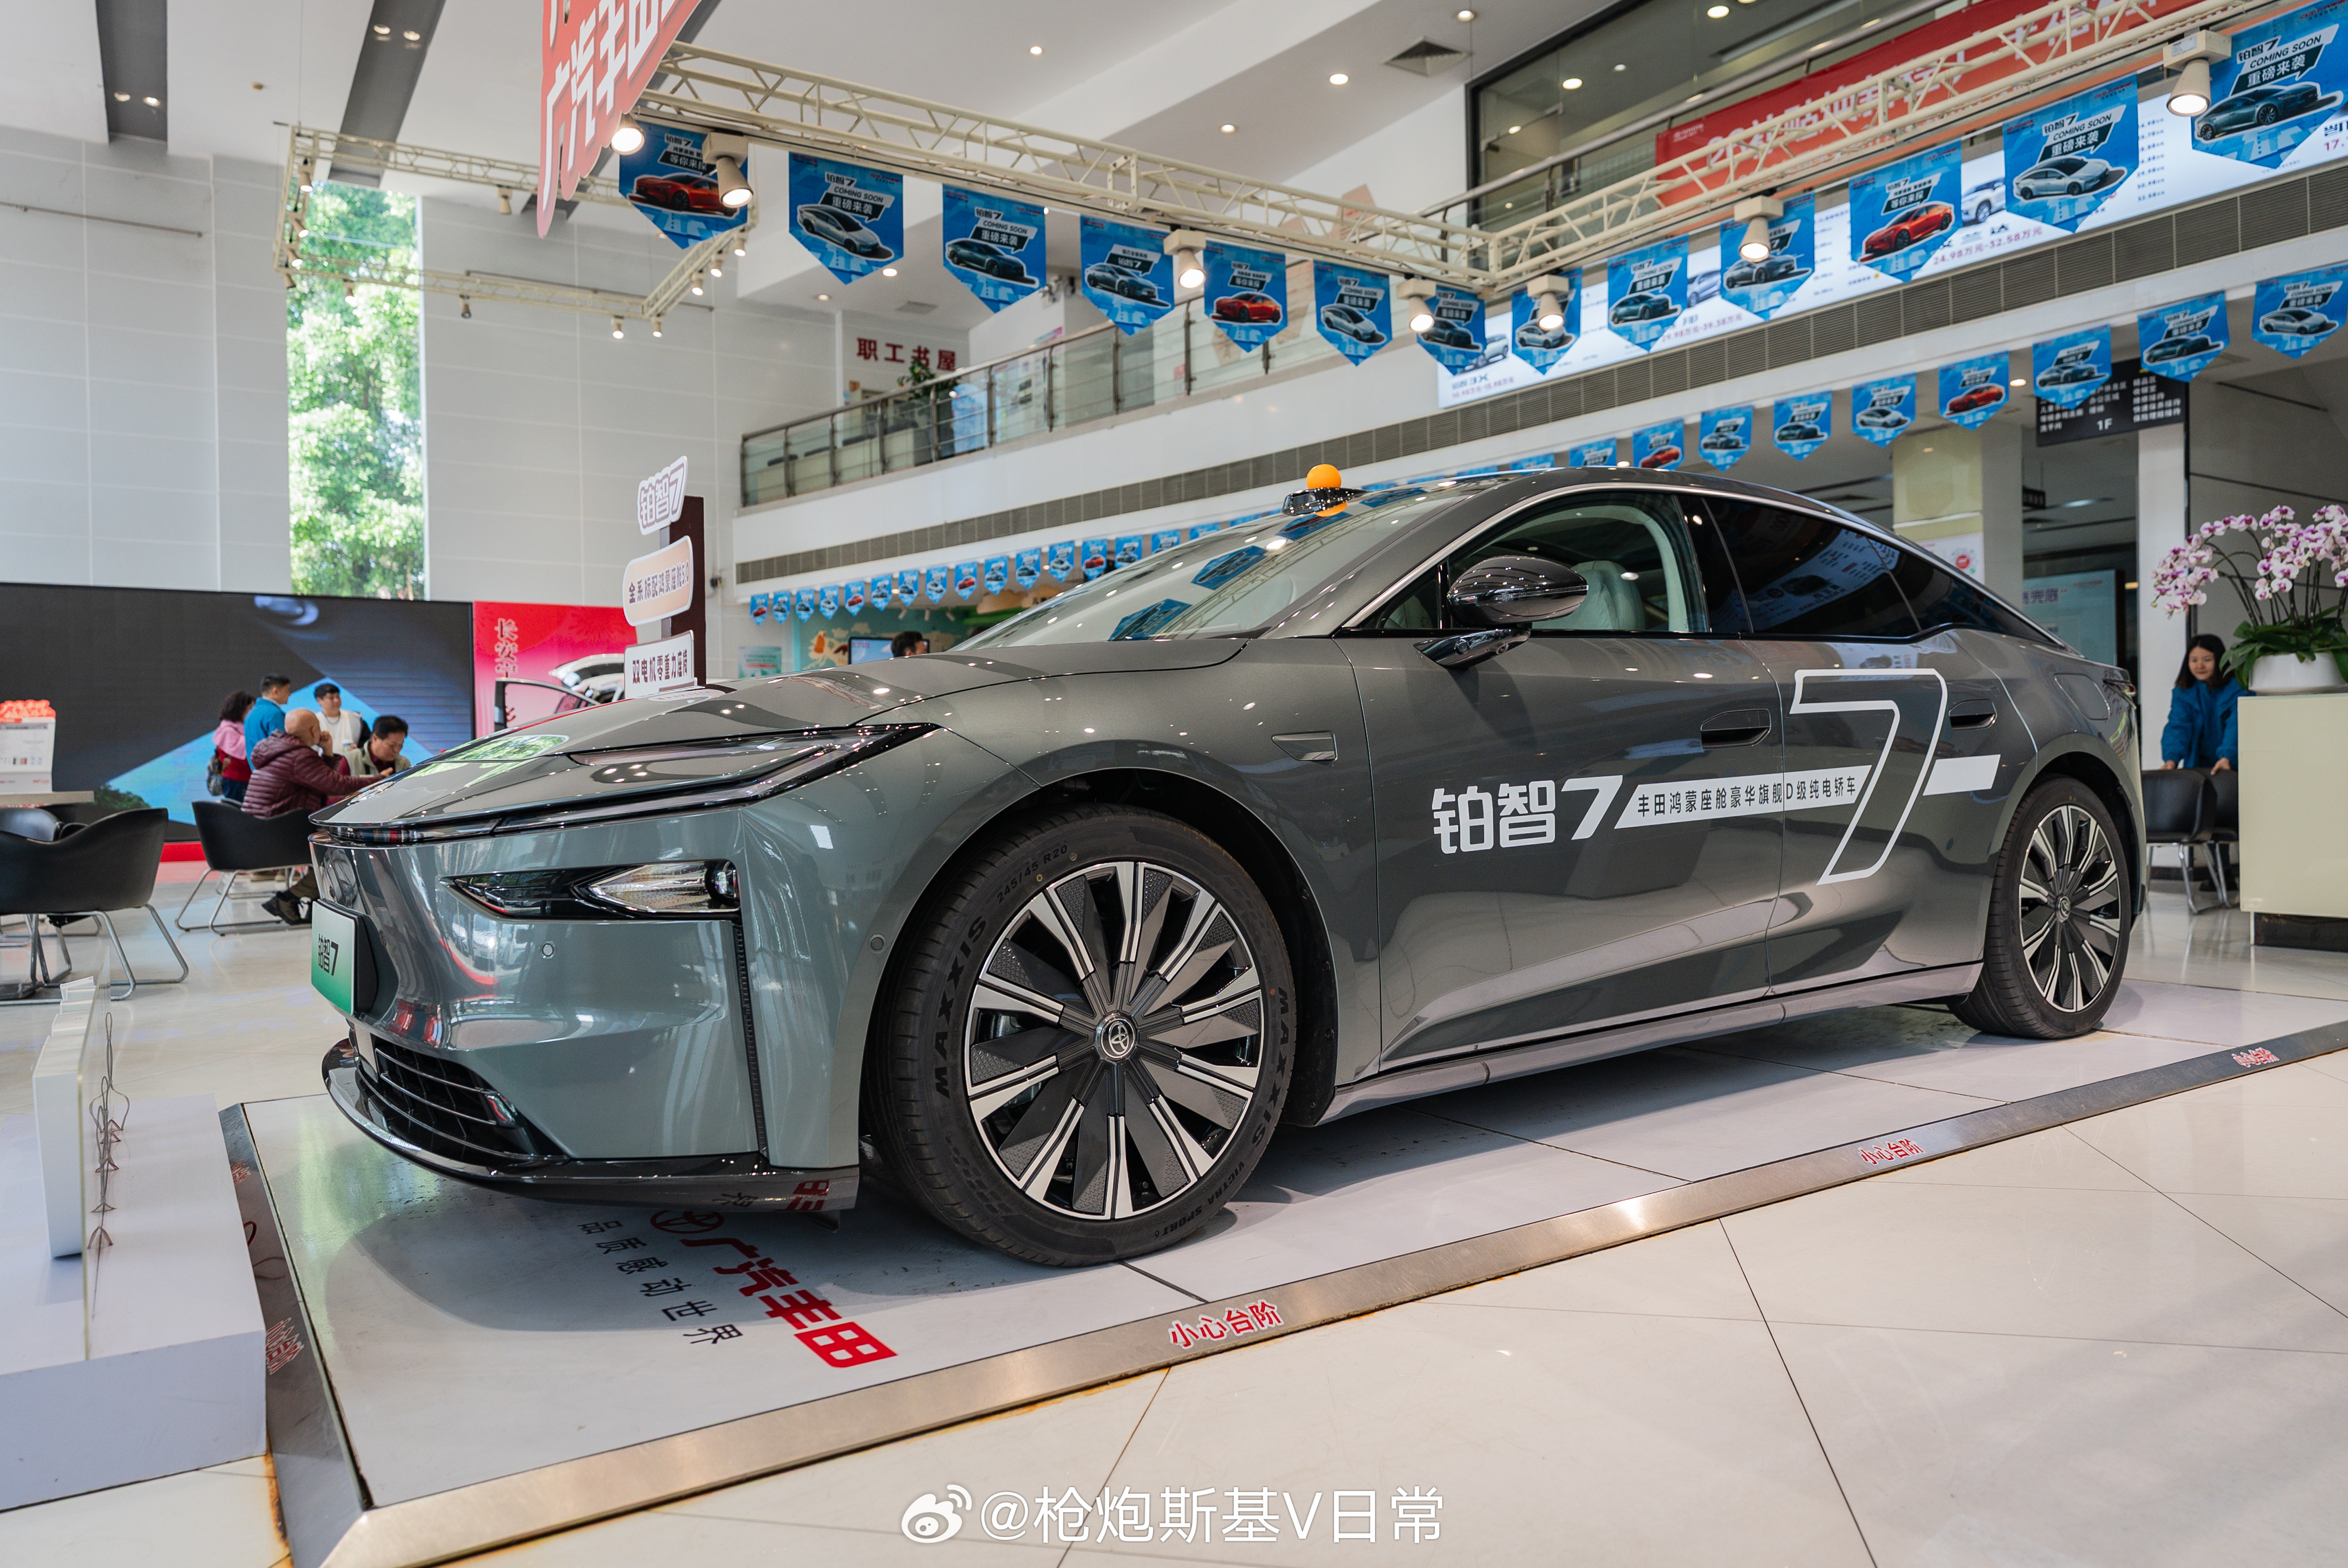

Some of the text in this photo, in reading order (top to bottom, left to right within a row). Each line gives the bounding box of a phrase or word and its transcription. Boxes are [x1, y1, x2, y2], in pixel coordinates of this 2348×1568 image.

[2238, 38, 2278, 61] 铂智7
[2251, 35, 2321, 69] COMING SOON
[2247, 54, 2305, 87] 重磅来袭
[2045, 115, 2077, 133] 铂智7
[2053, 114, 2112, 141] COMING SOON
[2051, 130, 2099, 157] 重磅来袭
[2324, 137, 2348, 152] 17.
[826, 173, 855, 186] 铂智7
[834, 186, 883, 203] COMING SOON
[832, 197, 873, 215] 重磅来袭
[976, 209, 1002, 220] 铂智7
[1891, 190, 1924, 208] 等你来探
[981, 230, 1018, 246] 重磅来袭
[983, 220, 1027, 234] COMING SOON
[857, 337, 956, 372] 职工书屋
[2097, 417, 2113, 431] 1F
[640, 463, 684, 529] 铂智7
[629, 559, 689, 605] 全系标配鸿蒙座舱5.0
[632, 648, 688, 684] 双电机零重力座椅
[1789, 668, 1947, 886] 7
[1638, 775, 1856, 818] 丰田鸿蒙座舱豪华旗舰D级纯电轿车
[1432, 775, 1623, 854] 铂智7
[996, 844, 1068, 904] 245/45 R20
[318, 933, 339, 977] 铂智7
[935, 915, 987, 1100] MAXXIS
[1252, 986, 1290, 1148] MAXXIS
[1860, 1137, 1925, 1165] 小心台阶
[1207, 1160, 1245, 1206] VICTRA
[1163, 1204, 1203, 1237] SPORT
[577, 1220, 744, 1344] 品质感动世界
[680, 1237, 899, 1368] 广汽丰田
[1170, 1301, 1283, 1348] 小心台阶
